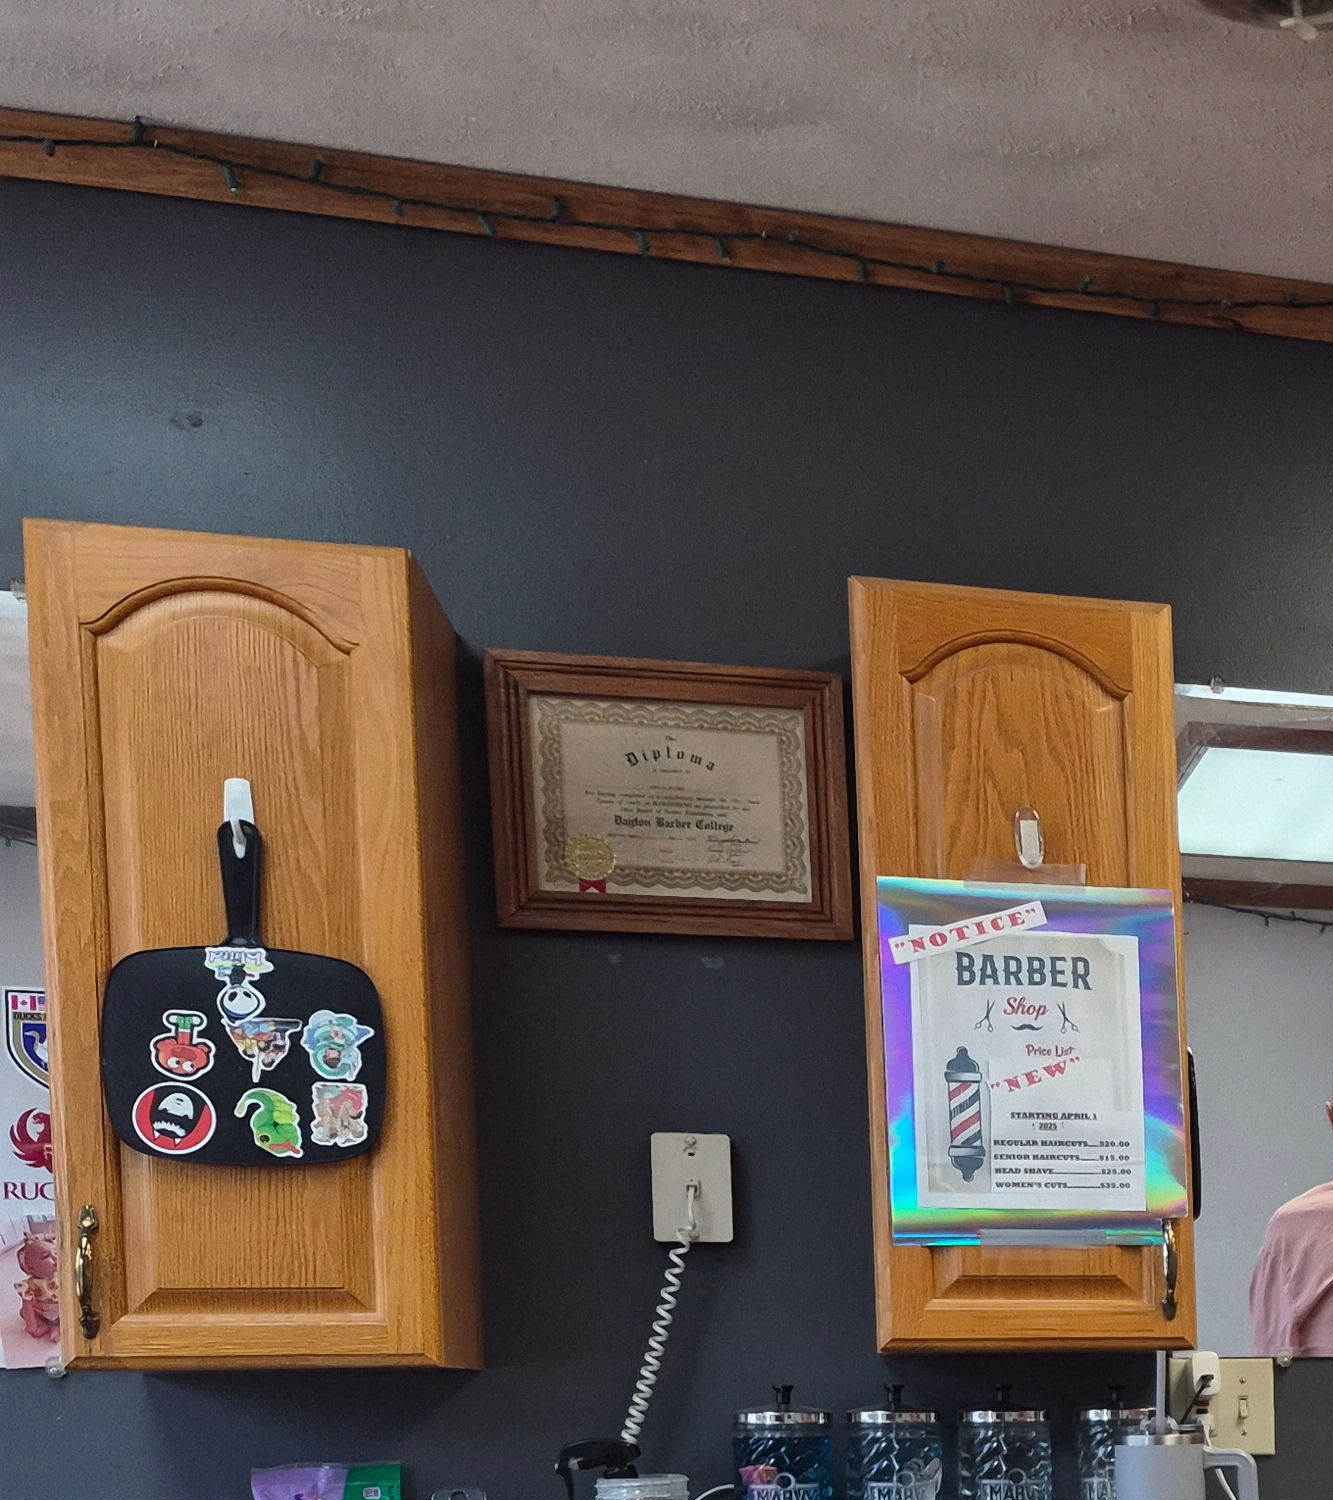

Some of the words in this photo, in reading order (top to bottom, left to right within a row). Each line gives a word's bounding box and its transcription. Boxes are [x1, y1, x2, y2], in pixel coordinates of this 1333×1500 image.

[624, 746, 716, 771] Diploma
[614, 814, 652, 828] Dayton
[655, 816, 692, 829] Barber
[695, 819, 735, 833] College
[955, 951, 1093, 991] BARBER
[13, 1012, 41, 1022] DUCKS
[1003, 997, 1049, 1024] Shop
[1025, 1044, 1052, 1057] Price
[1055, 1045, 1076, 1058] List
[1010, 1112, 1058, 1120] STARTING
[1061, 1112, 1091, 1121] APRIL
[1038, 1122, 1058, 1131] 2025
[993, 1139, 1039, 1147] REGULAR
